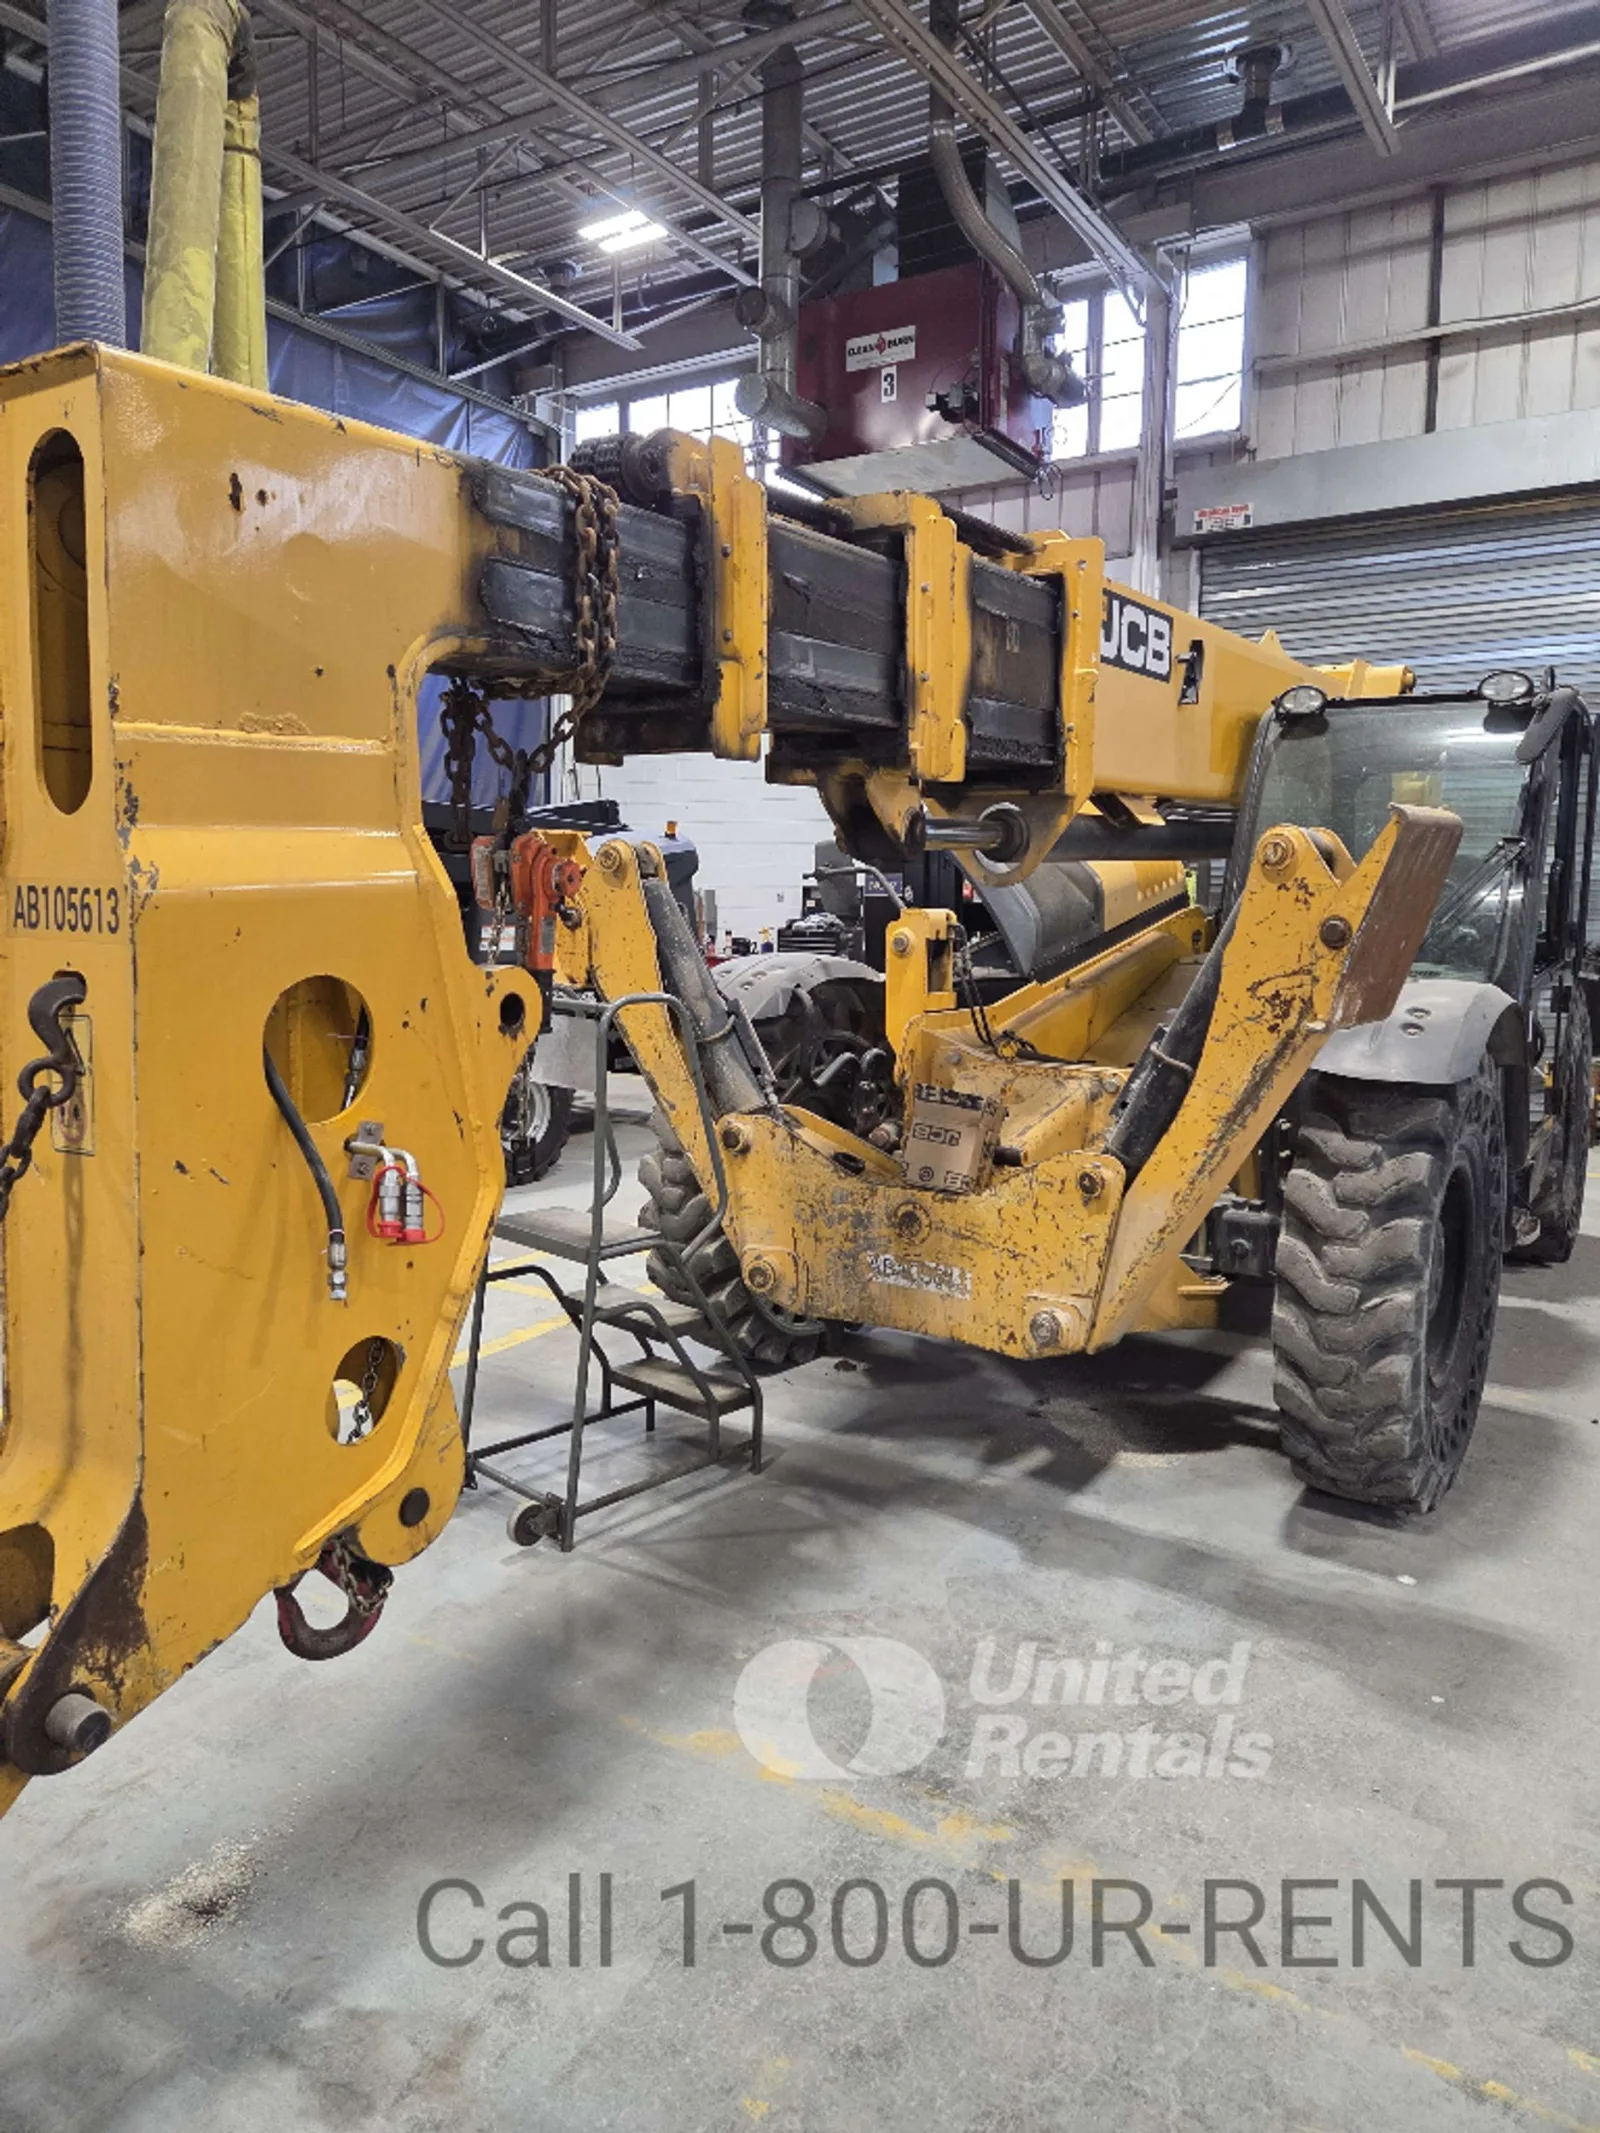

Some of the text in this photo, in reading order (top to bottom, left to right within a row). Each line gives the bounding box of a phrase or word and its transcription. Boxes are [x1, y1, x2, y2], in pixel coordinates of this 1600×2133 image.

[848, 342, 874, 357] CLEAN
[883, 372, 895, 397] 3
[1101, 598, 1170, 677] JCB
[13, 885, 119, 934] AB105613
